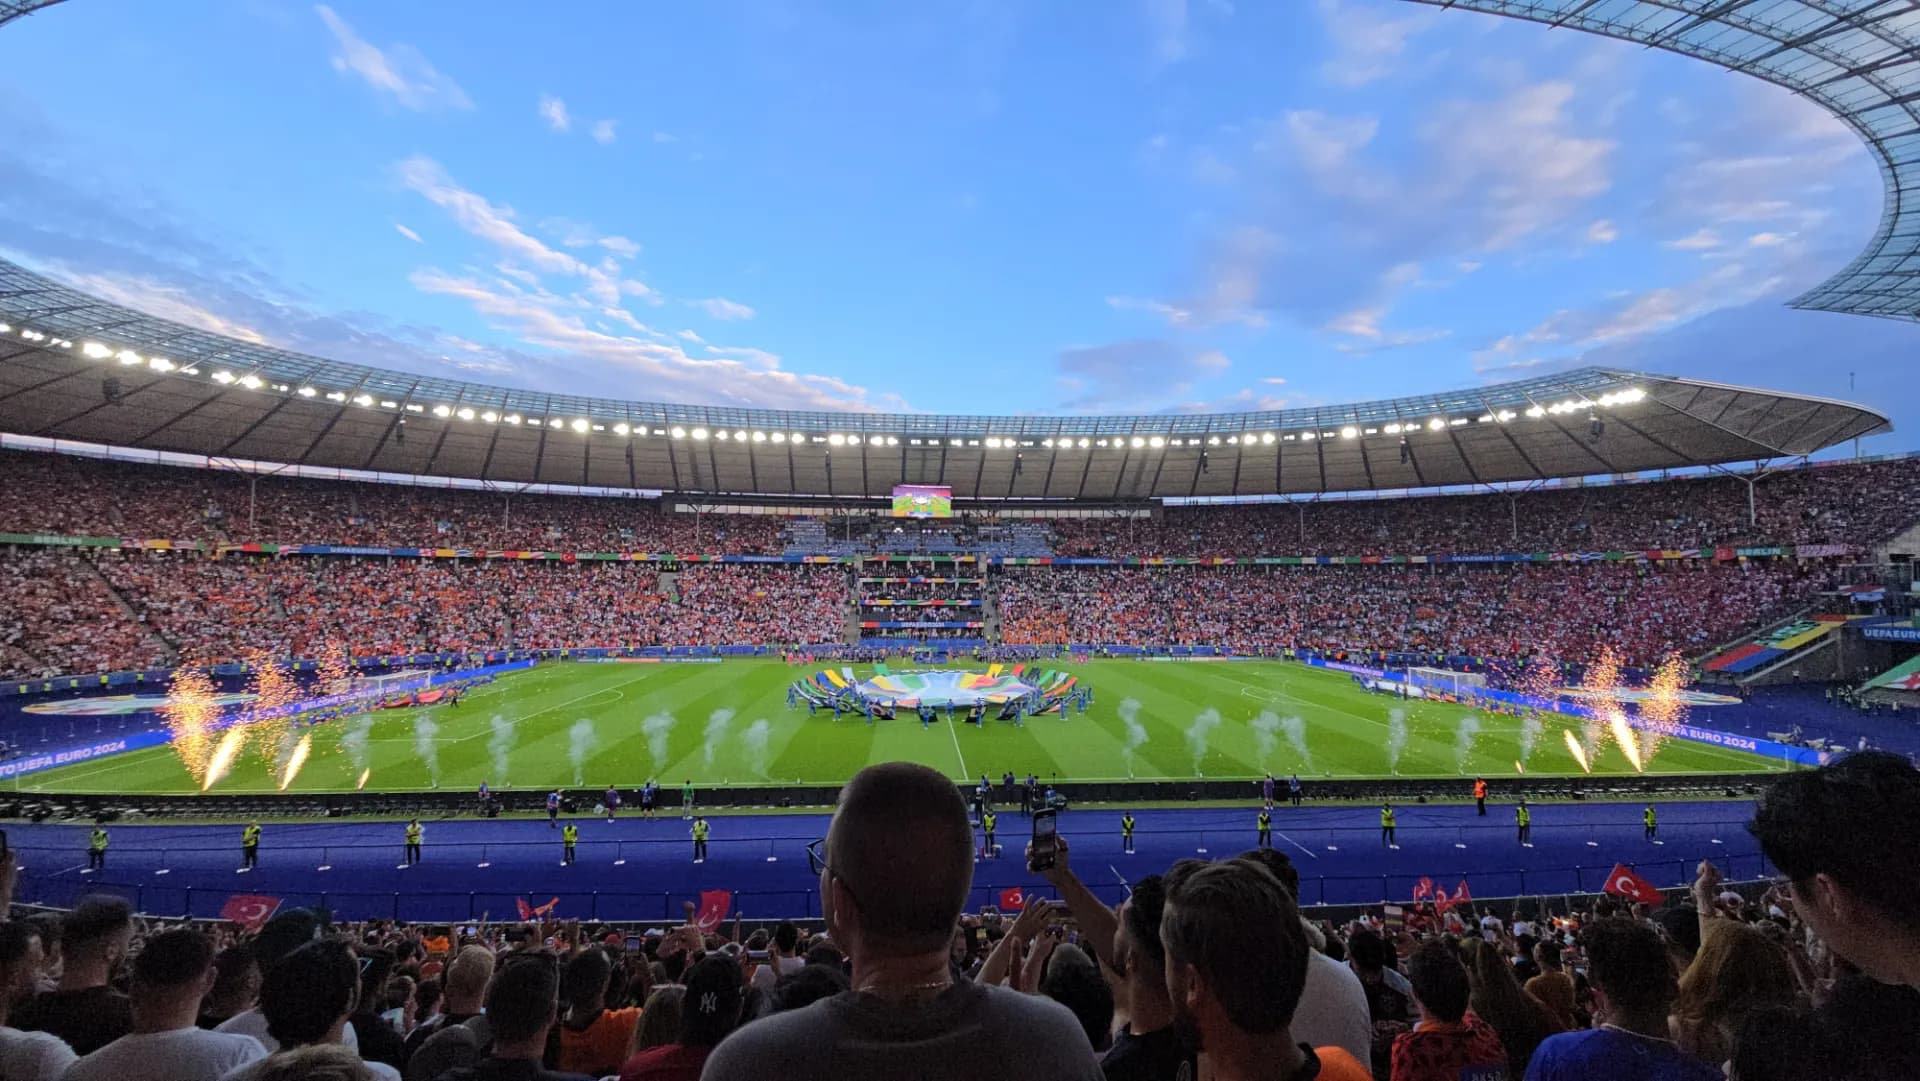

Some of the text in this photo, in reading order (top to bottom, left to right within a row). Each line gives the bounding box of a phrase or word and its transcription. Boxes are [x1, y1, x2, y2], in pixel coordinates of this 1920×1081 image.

[1690, 728, 1721, 743] EURO
[1723, 736, 1756, 751] 2024
[16, 756, 53, 773] UEFA
[55, 748, 92, 764] EURO
[93, 740, 126, 757] 2024
